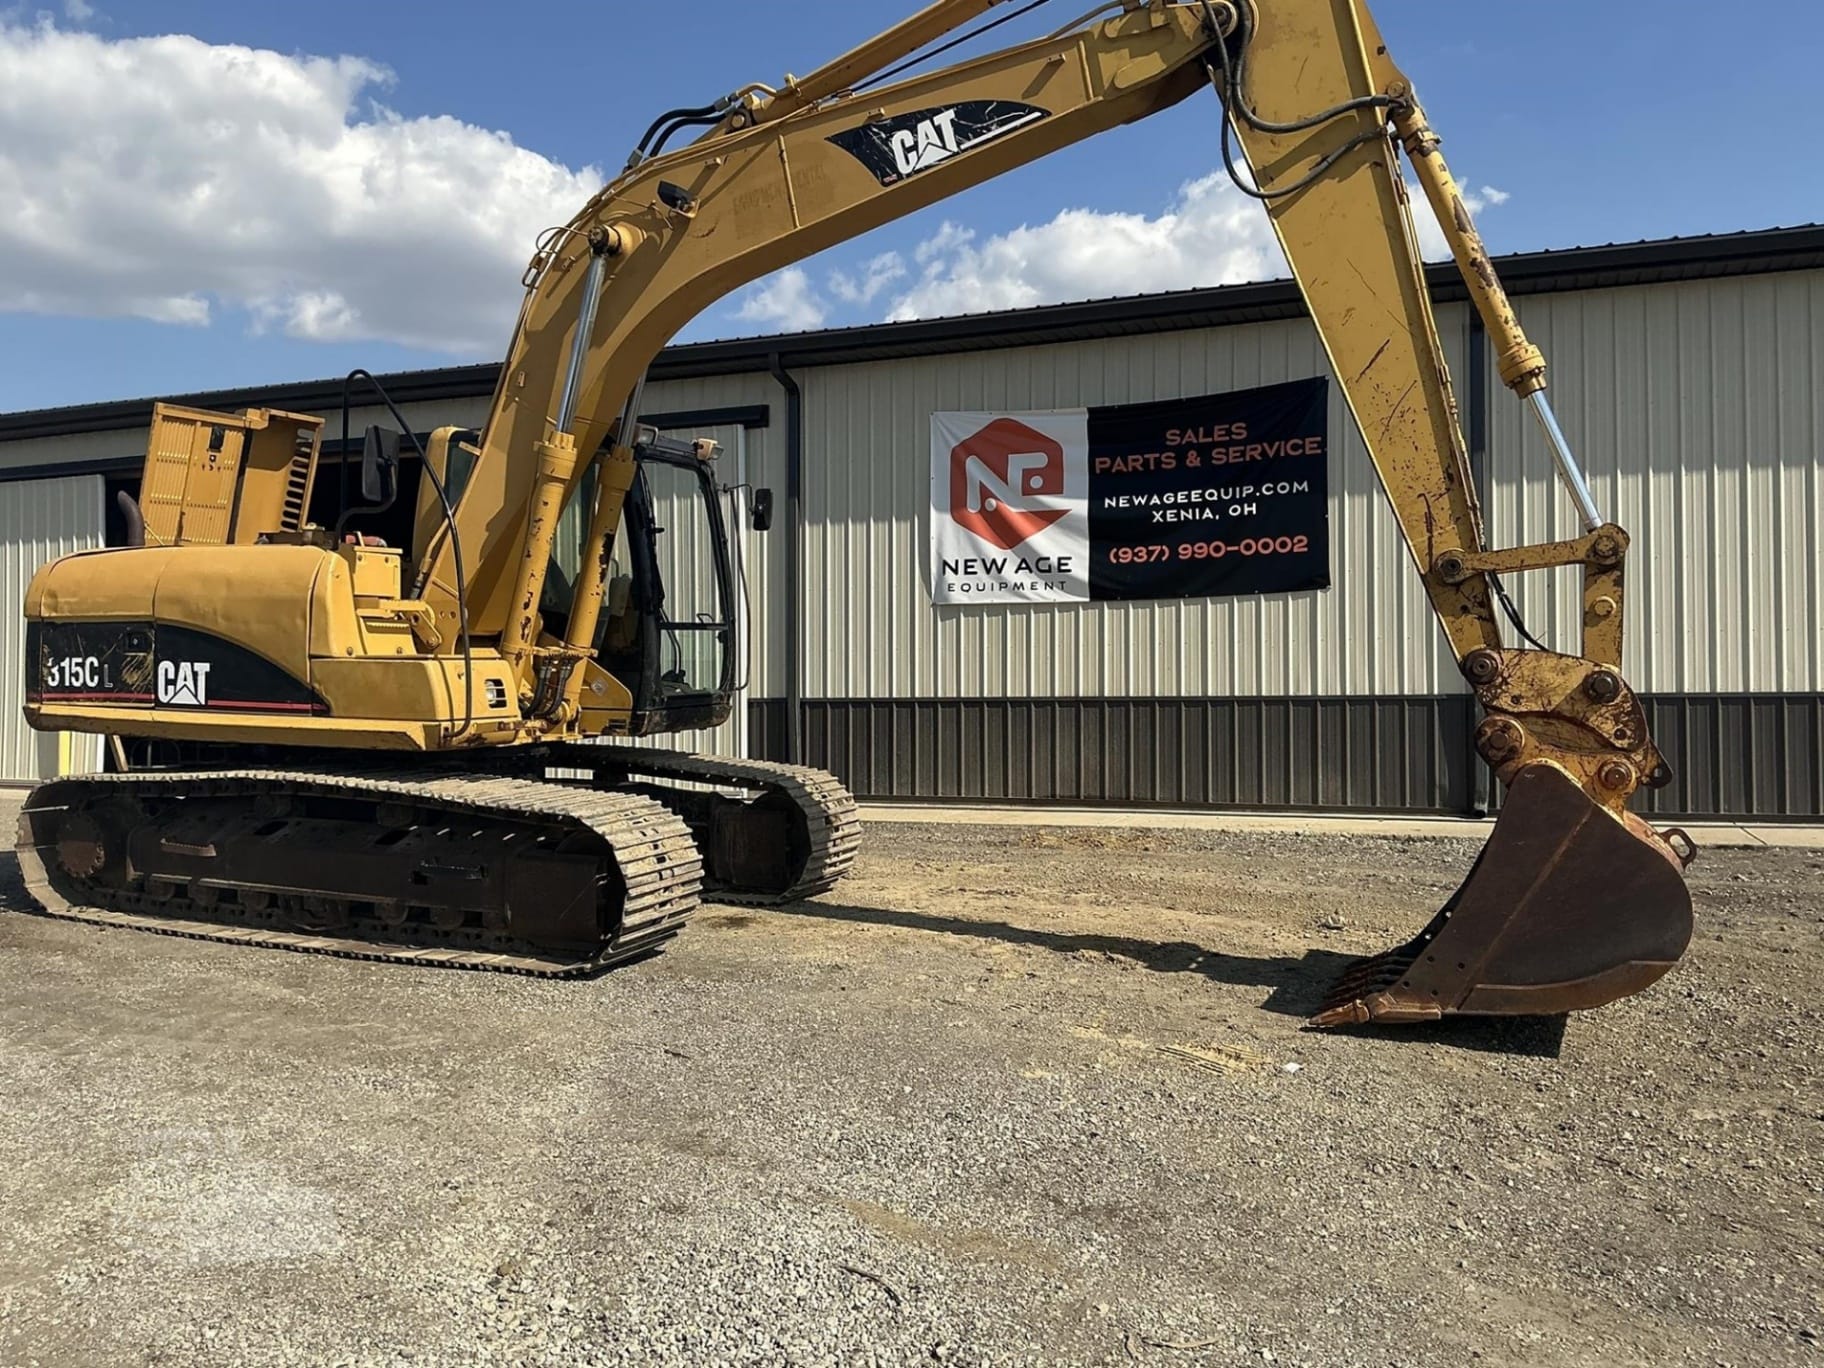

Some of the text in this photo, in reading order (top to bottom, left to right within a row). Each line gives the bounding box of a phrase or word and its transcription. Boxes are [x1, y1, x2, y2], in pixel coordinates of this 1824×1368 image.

[892, 109, 959, 174] CAT
[1165, 422, 1248, 446] SALES
[1095, 437, 1322, 474] PARTS & SERVICE
[1104, 480, 1309, 508] NEWAGEEQUIP.COM
[1152, 503, 1257, 523] XENIA, OH
[1109, 535, 1308, 564] (937) 990-0002
[943, 556, 1073, 576] NEW AGE
[947, 580, 1067, 593] EQUIPMENT
[158, 660, 210, 705] CAT
